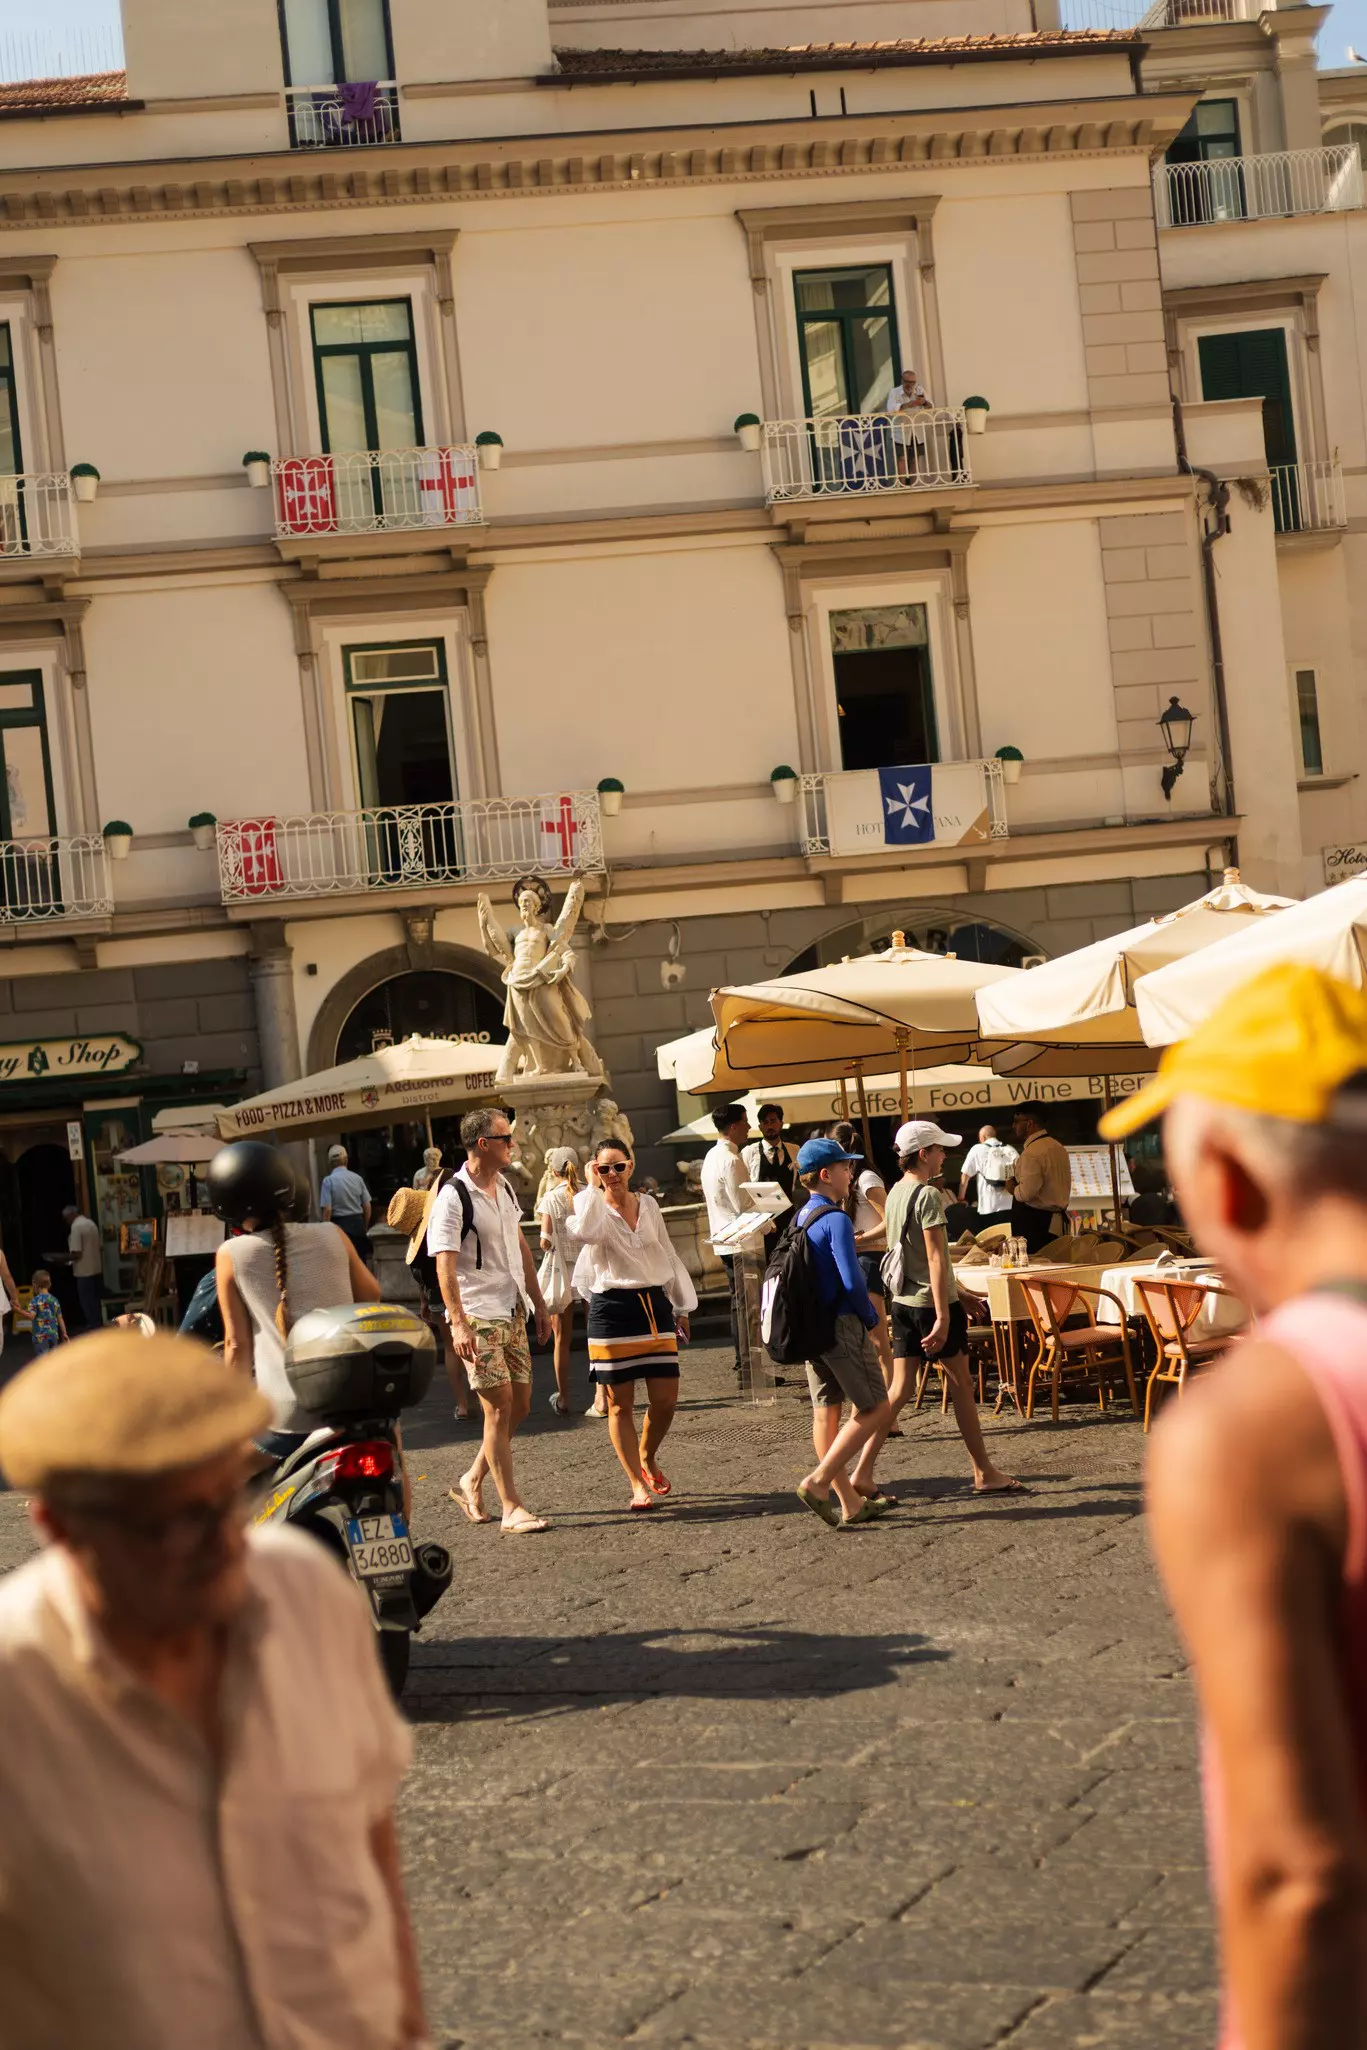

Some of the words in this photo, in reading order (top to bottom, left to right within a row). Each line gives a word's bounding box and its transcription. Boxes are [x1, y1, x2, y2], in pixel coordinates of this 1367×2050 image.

[57, 1041, 122, 1069] Shop
[385, 1077, 455, 1095] Alduomo
[402, 1091, 440, 1105] bistrot
[831, 1092, 914, 1116] Coffee
[929, 1083, 991, 1108] Food
[1007, 1080, 1072, 1101] Wine
[1088, 1075, 1146, 1096] Beer
[360, 1518, 385, 1541] EZ
[355, 1542, 411, 1570] 34880
